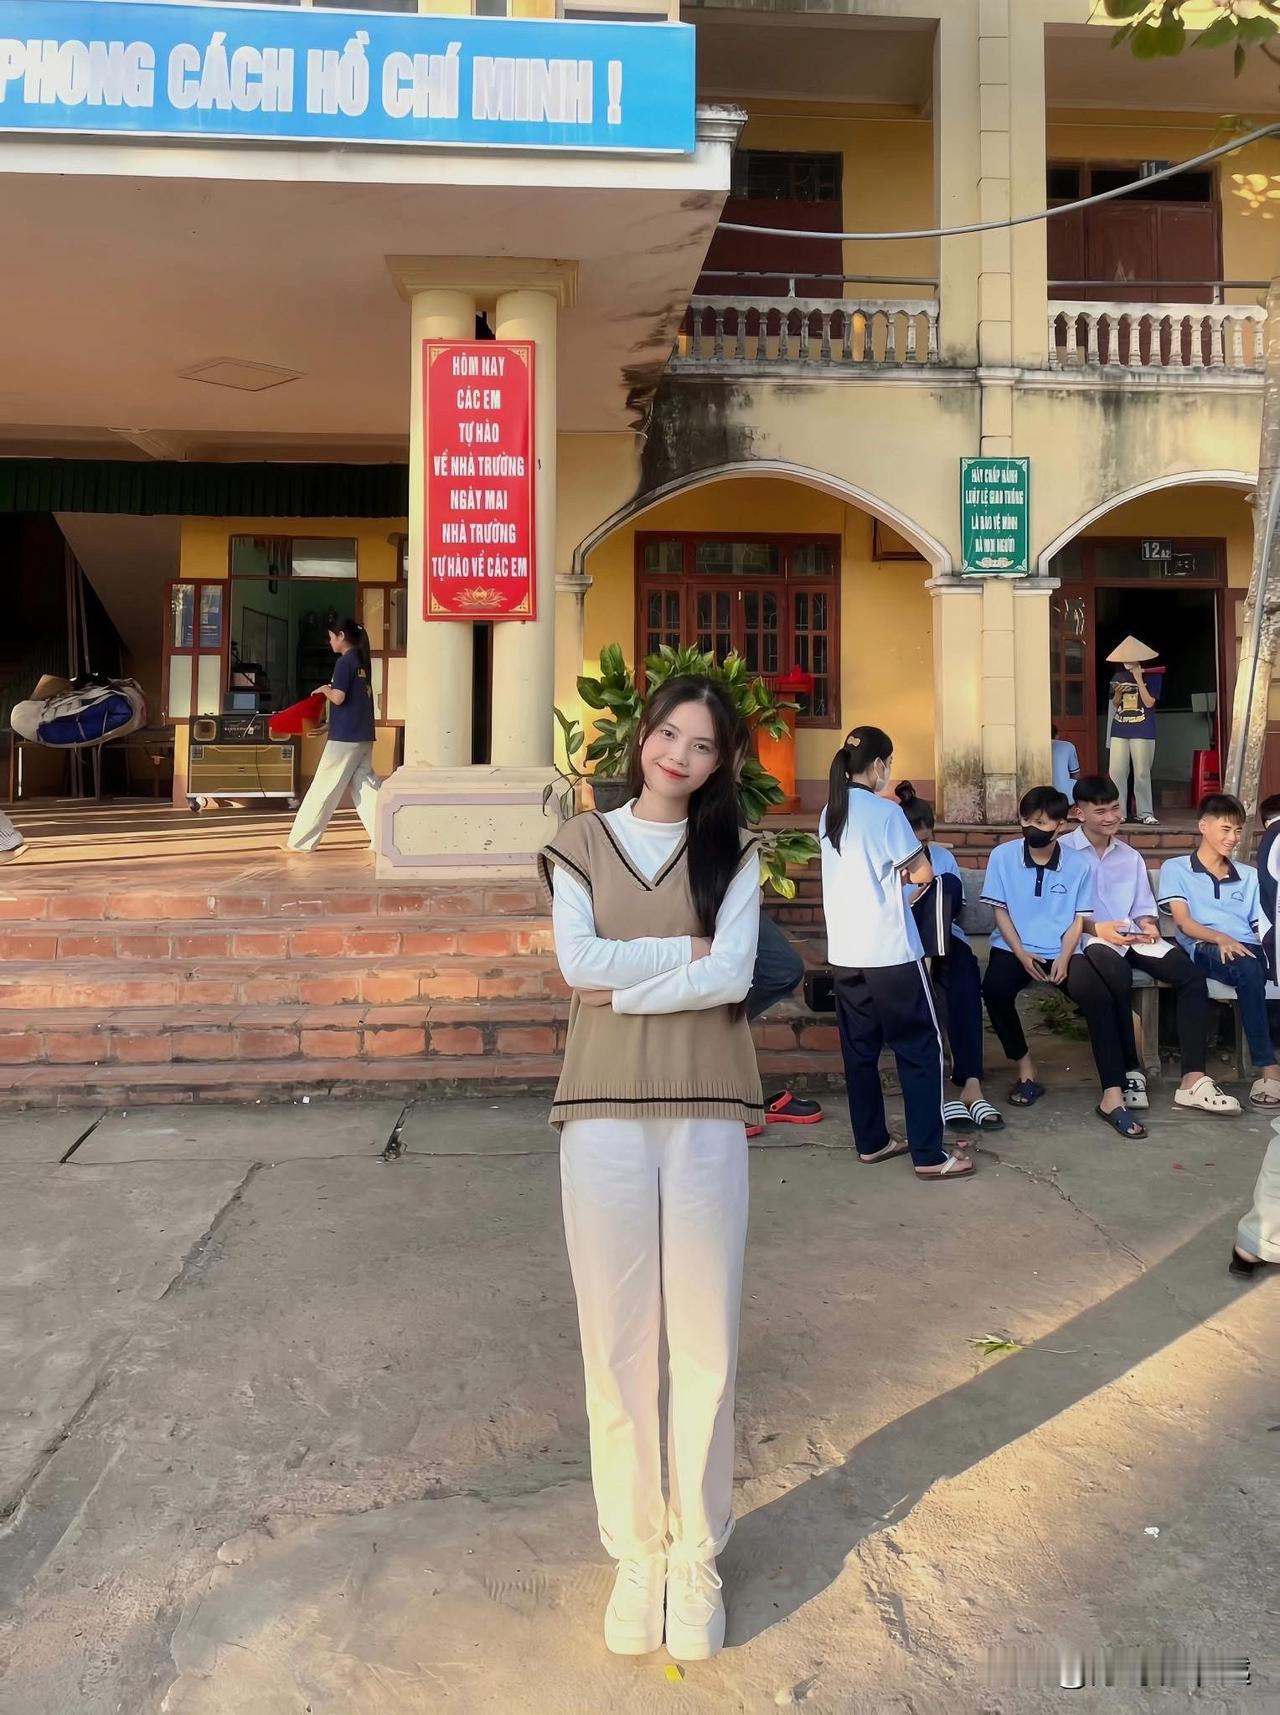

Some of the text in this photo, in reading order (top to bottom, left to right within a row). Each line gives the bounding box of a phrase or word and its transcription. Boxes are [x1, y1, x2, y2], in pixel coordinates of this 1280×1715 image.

[0, 30, 623, 125] PHONG CÁCH HỒ CHÍ MINH !
[452, 352, 505, 377] HÔM NAY
[456, 385, 501, 410] CÁC EM
[458, 418, 500, 448] TỰ HÀO
[433, 448, 525, 477] VỀ NHÀ TRƯỜNG
[450, 485, 508, 510] NGÀY MAI
[442, 517, 517, 544] NHÀ TRƯỜNG
[431, 549, 528, 582] TỰ HÀO VỀ CÁC EM
